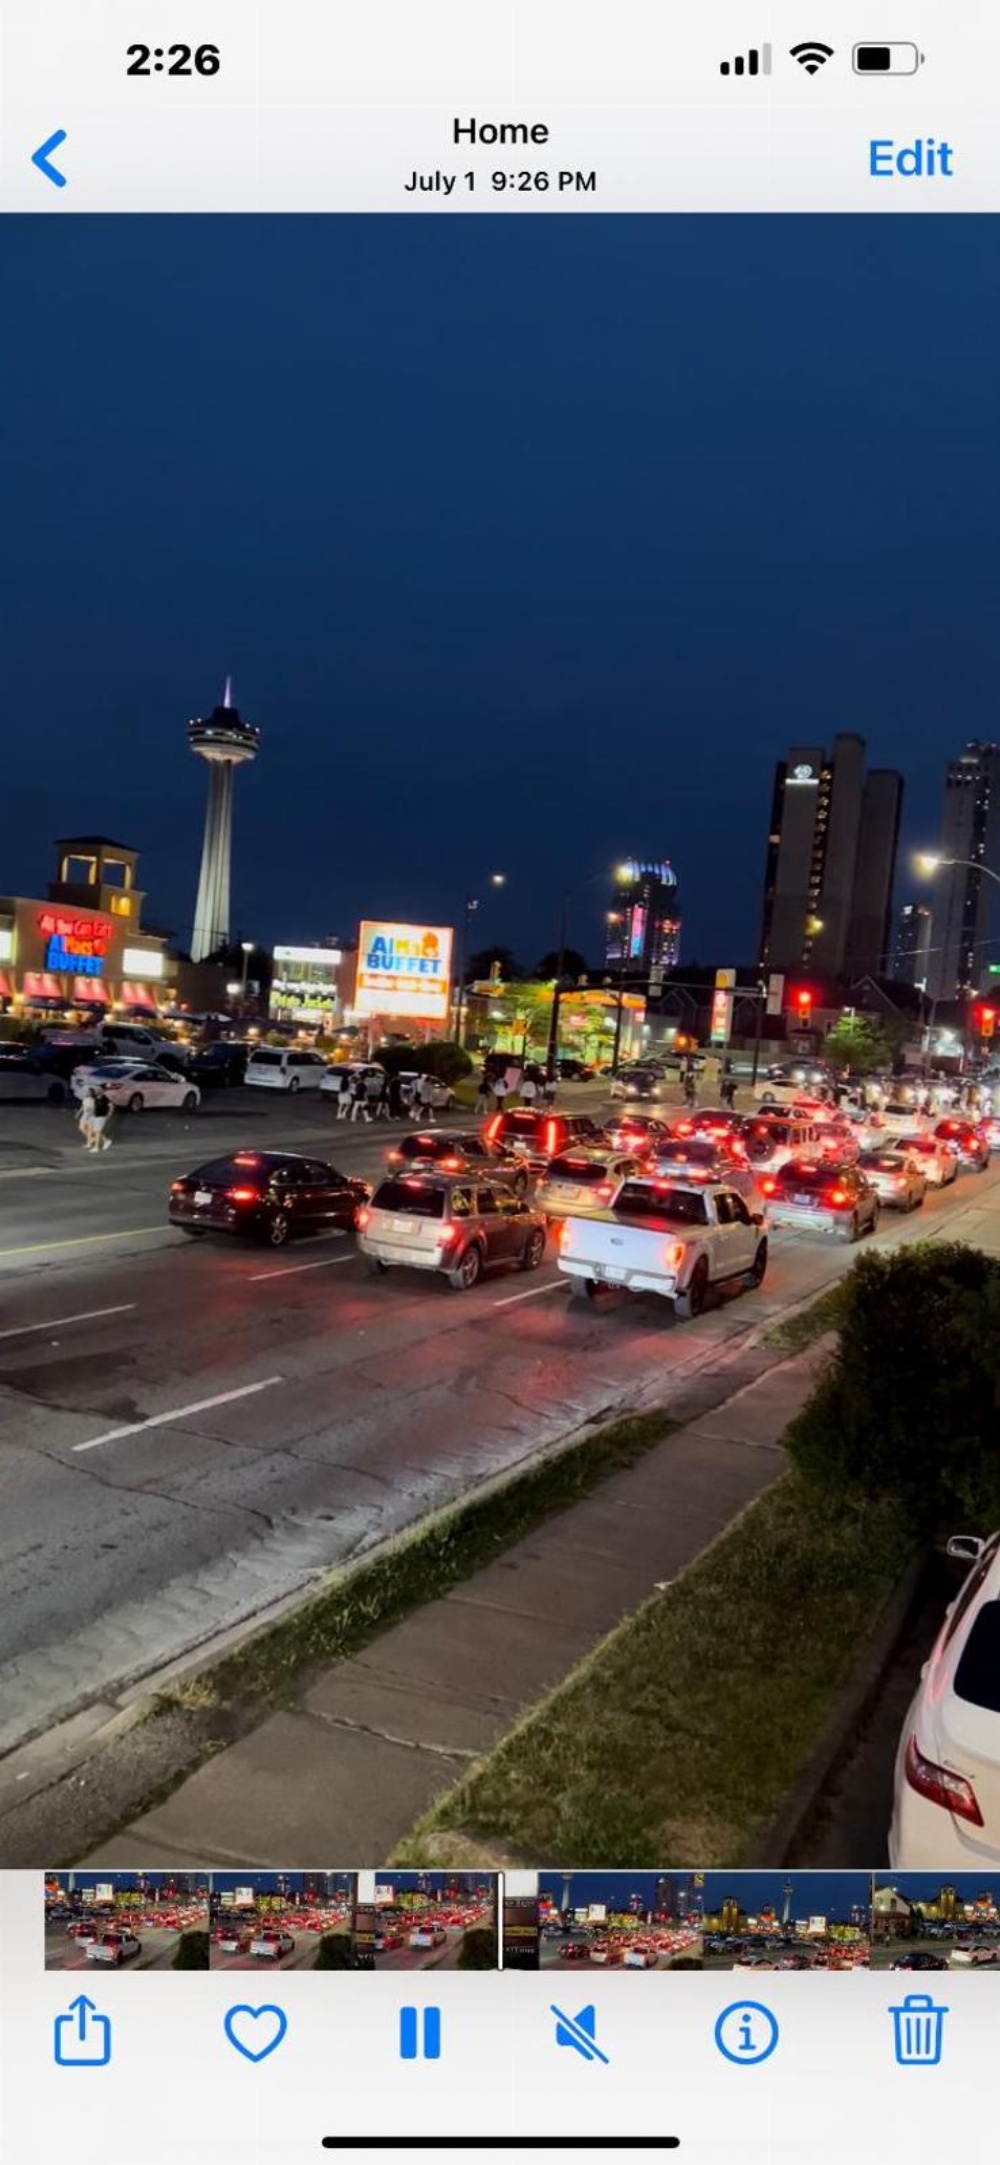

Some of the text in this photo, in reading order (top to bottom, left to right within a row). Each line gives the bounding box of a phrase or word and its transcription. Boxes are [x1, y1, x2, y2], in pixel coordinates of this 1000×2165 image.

[126, 43, 221, 77] 2:26
[453, 117, 550, 145] Home
[869, 138, 953, 177] Edit
[403, 170, 597, 196] July 1 9:26 PM
[46, 950, 105, 976] BUFFET
[366, 953, 442, 974] BUFFET
